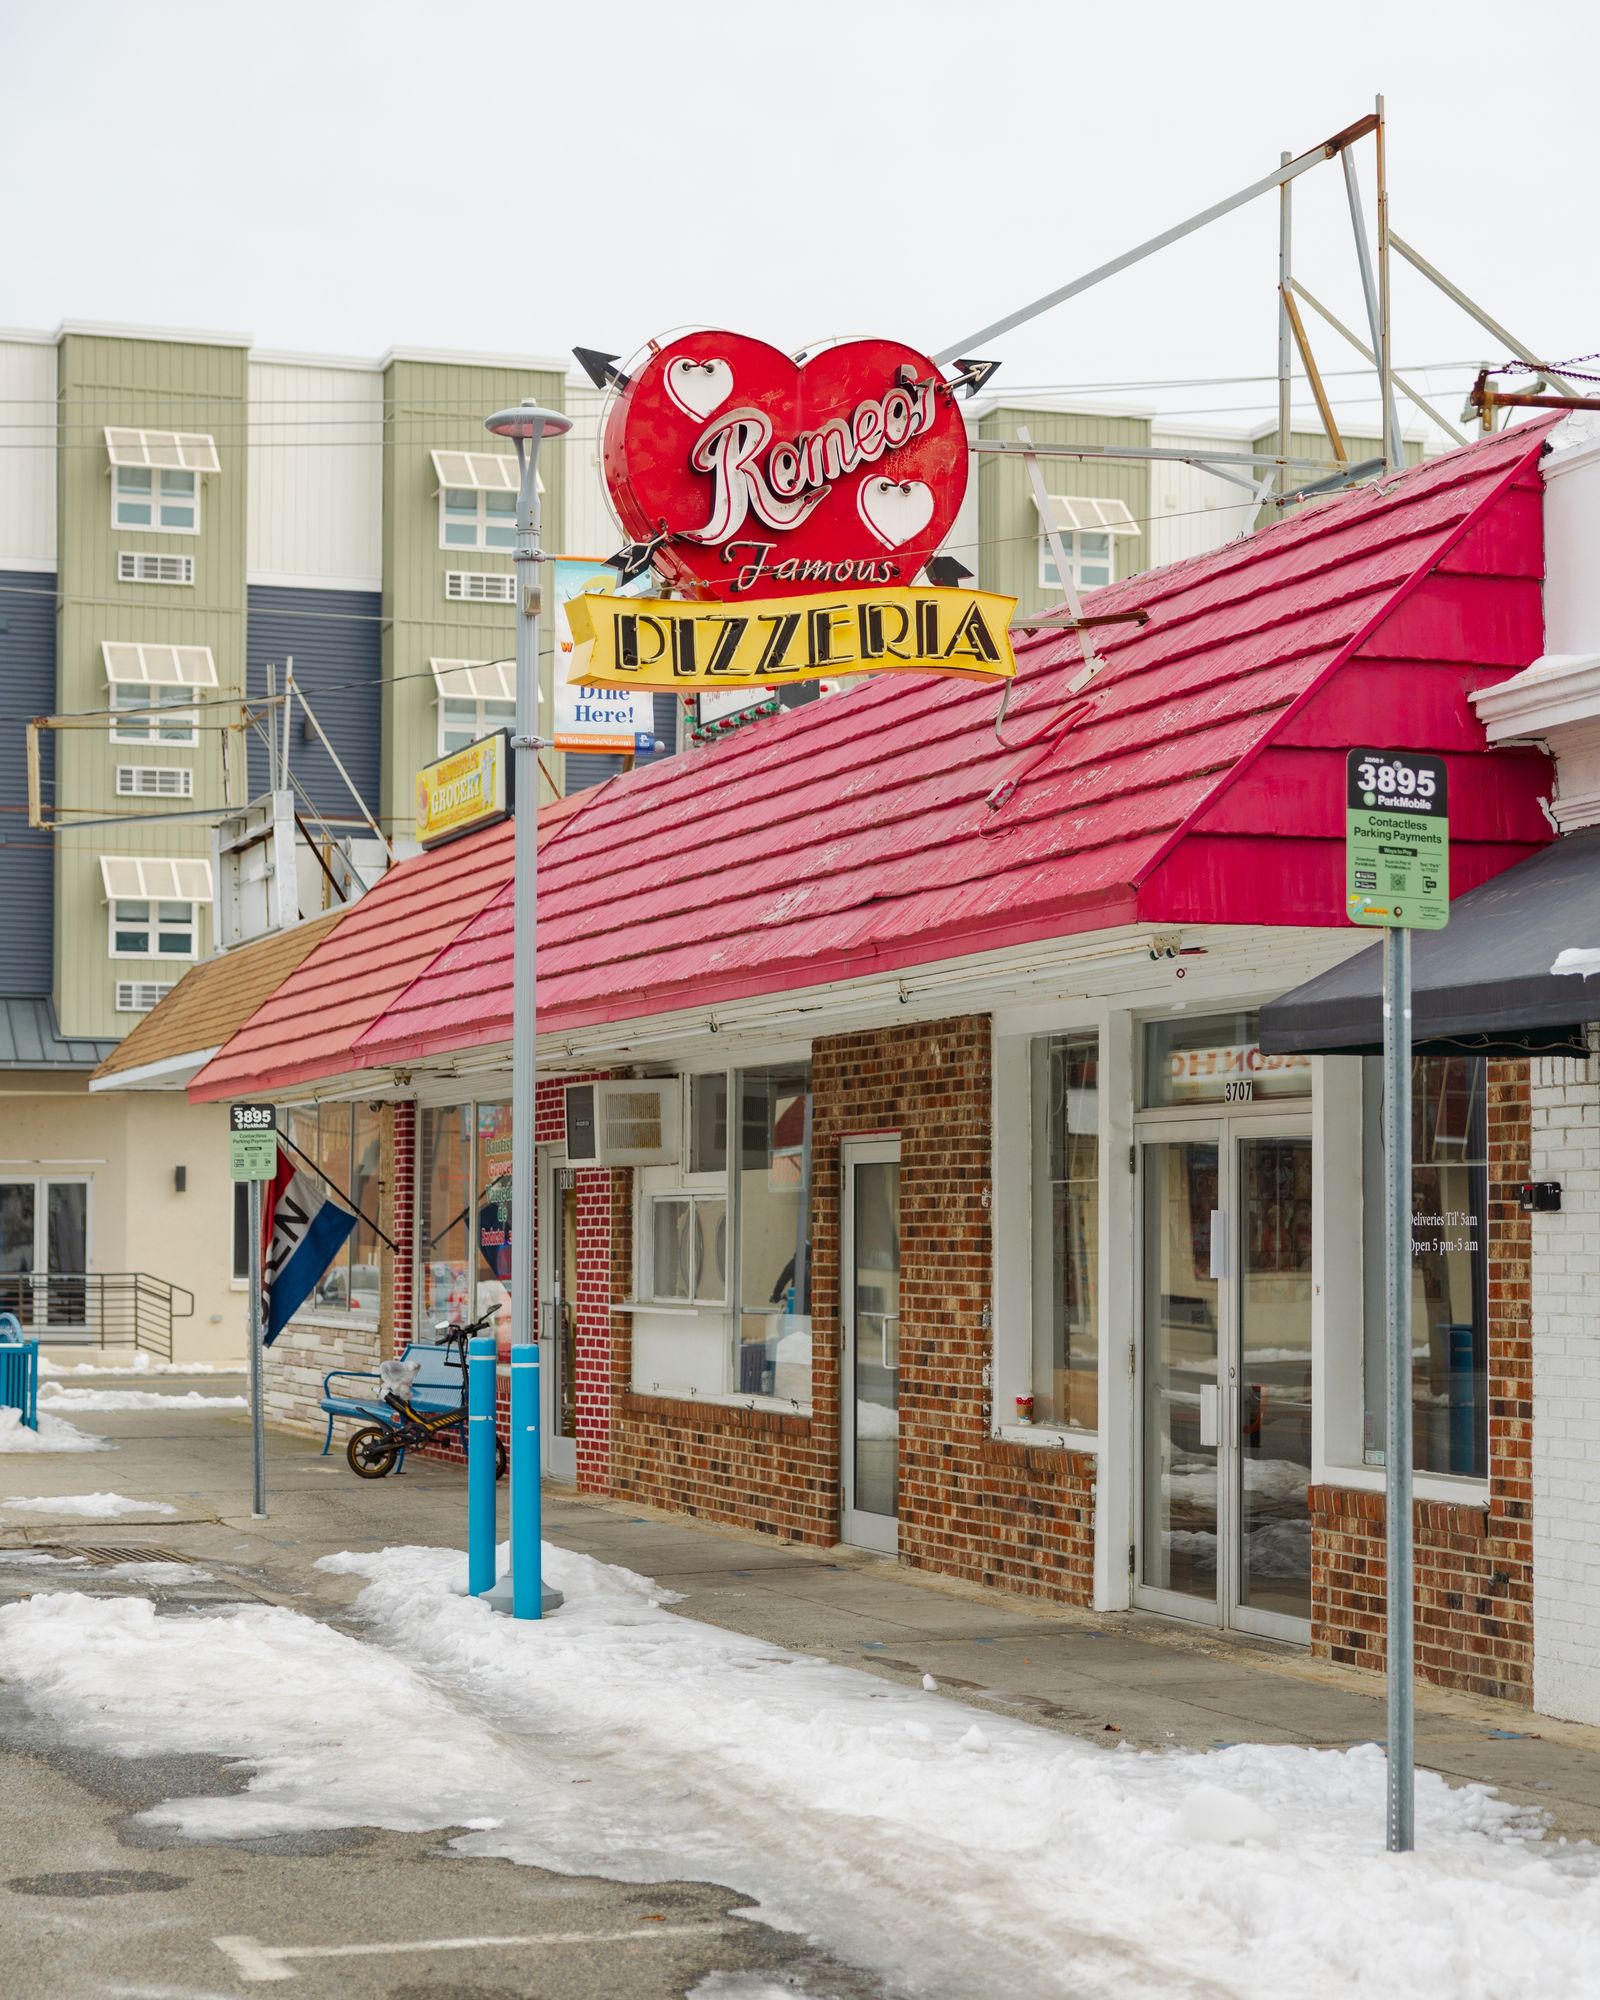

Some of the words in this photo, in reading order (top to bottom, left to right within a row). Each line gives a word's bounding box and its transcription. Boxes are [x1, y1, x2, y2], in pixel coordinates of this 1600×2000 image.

[676, 364, 937, 546] Romeo's
[721, 540, 895, 592] Famous
[613, 599, 1003, 677] PIZZERIA
[578, 685, 630, 701] Dine
[574, 704, 634, 723] Here!
[559, 736, 632, 746] WildwoodsNJ.com
[1357, 763, 1436, 797] 3895
[432, 772, 481, 815] GROCERY
[1377, 795, 1432, 810] ParkMobile
[1368, 816, 1428, 831] Contactless
[1354, 827, 1392, 841] Parking
[1393, 830, 1442, 844] Payments
[1225, 1082, 1252, 1102] 3707
[234, 1110, 271, 1123] 3895
[497, 1203, 508, 1222] de
[1460, 1212, 1478, 1226] 5am
[1432, 1238, 1438, 1251] 5
[1440, 1238, 1463, 1256] pm-5
[1464, 1240, 1479, 1251] am
